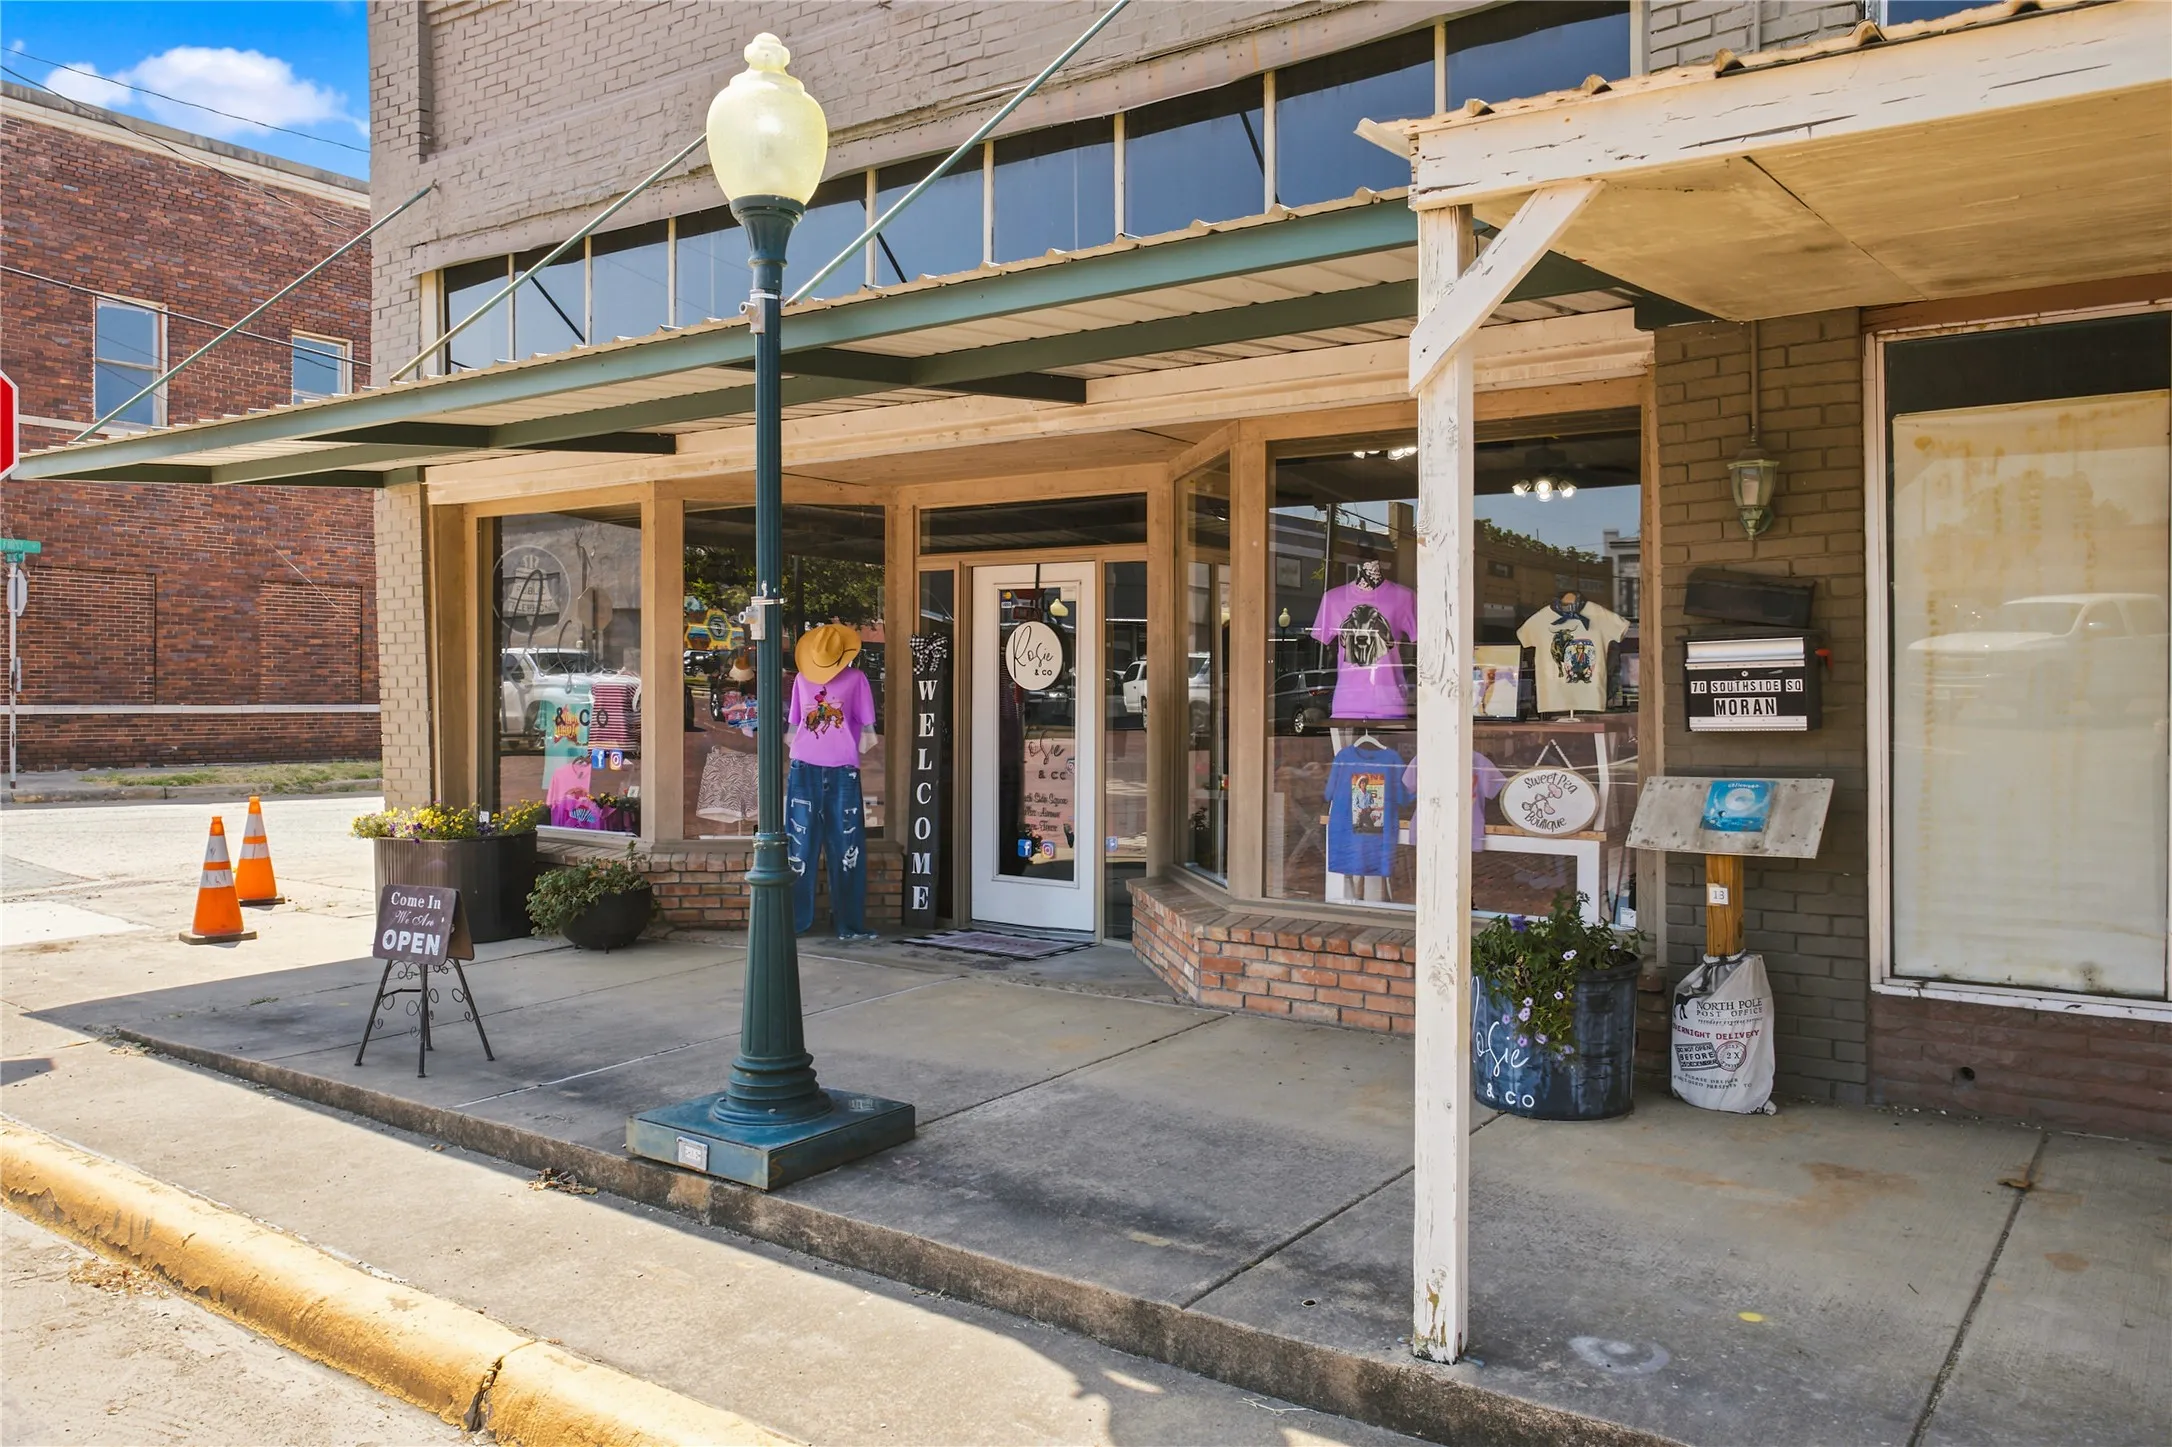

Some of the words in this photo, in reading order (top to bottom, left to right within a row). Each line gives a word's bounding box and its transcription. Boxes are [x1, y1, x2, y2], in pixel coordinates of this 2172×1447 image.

[1013, 625, 1053, 678] Rosie
[1034, 668, 1040, 676] &
[1692, 682, 1705, 692] 70
[1712, 680, 1780, 692] SOUTHSIDE
[1787, 680, 1802, 691] SQ
[1715, 698, 1775, 715] MORAN
[555, 706, 566, 726] &
[1038, 770, 1046, 779] &
[1524, 773, 1558, 789] Sweet
[1557, 774, 1578, 794] Pea
[911, 680, 938, 910] WELCOME
[1524, 811, 1567, 832] Boutique
[391, 891, 425, 908] Come
[427, 894, 441, 909] In
[395, 910, 412, 924] We
[412, 912, 434, 927] Are
[382, 929, 440, 956] OPEN
[1696, 1001, 1734, 1011] NORTH
[1739, 998, 1763, 1009] POLE
[1696, 1010, 1721, 1018] POST
[1731, 1006, 1763, 1017] OFFICE
[1680, 1052, 1716, 1061] BEFORE
[1694, 1044, 1712, 1052] OPEN
[1486, 1082, 1495, 1099] &
[1505, 1091, 1535, 1108] CO
